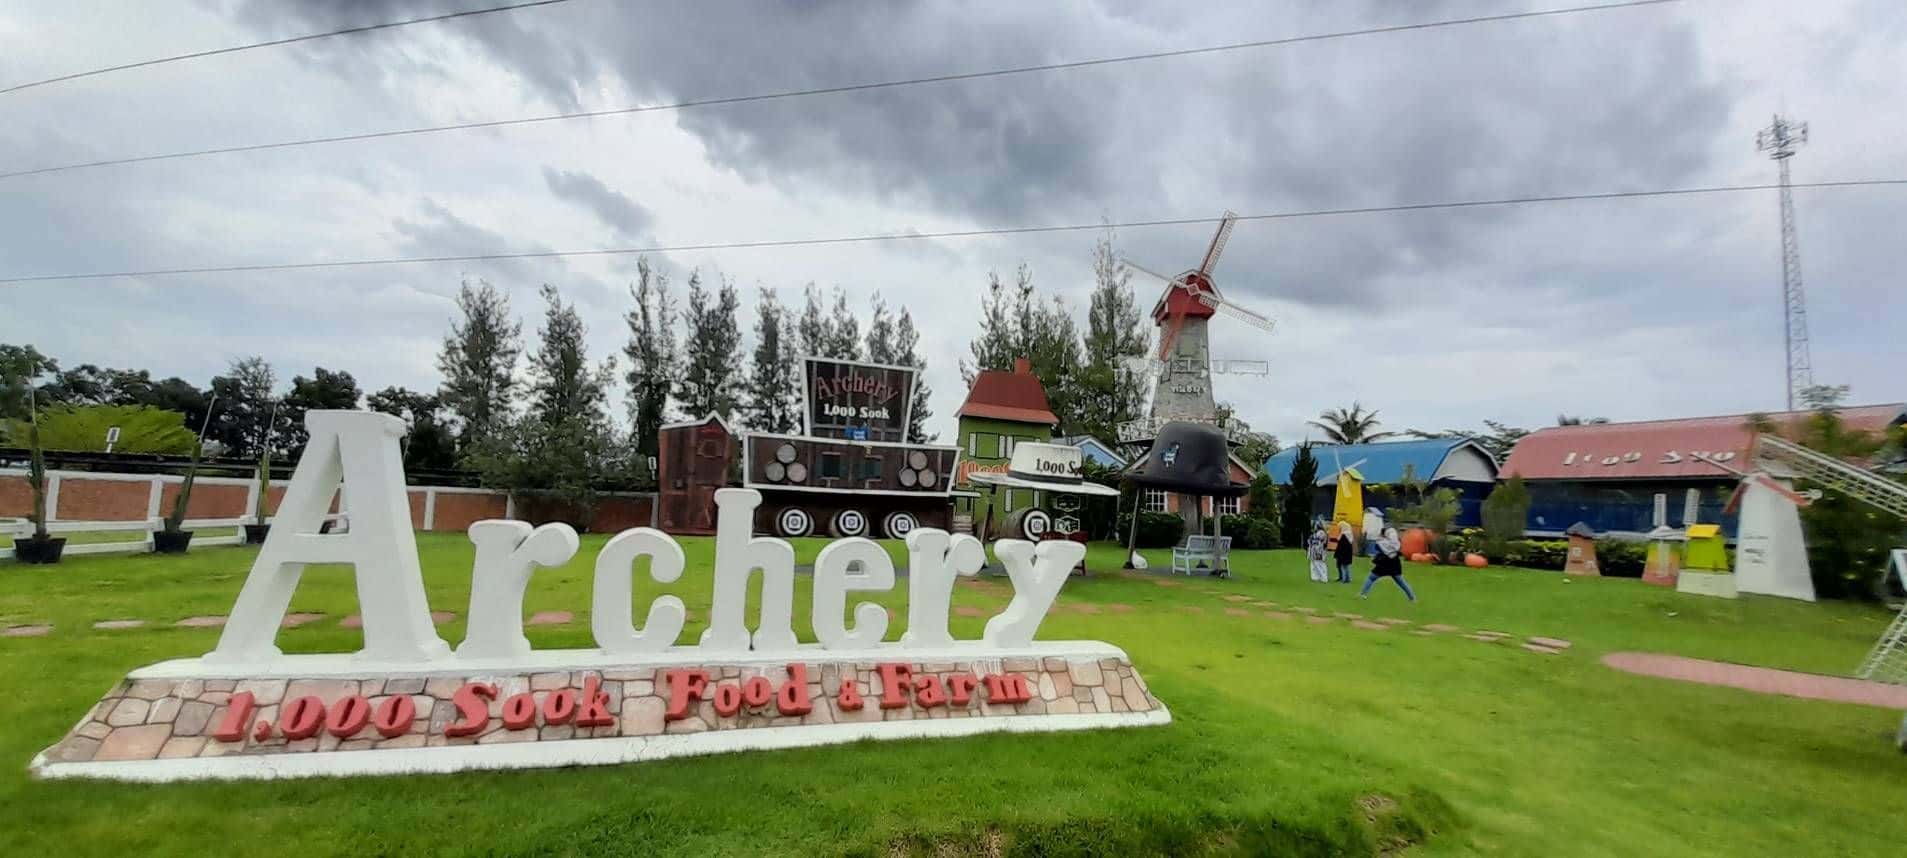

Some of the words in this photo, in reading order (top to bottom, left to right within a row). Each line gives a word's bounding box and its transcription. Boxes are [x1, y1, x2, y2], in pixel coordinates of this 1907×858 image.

[816, 370, 898, 404] Archery
[859, 407, 890, 420] Sook
[1036, 458, 1065, 474] 1,000
[200, 409, 1087, 663] Archery
[214, 690, 416, 742] 1,000
[444, 675, 614, 738] Sook
[664, 663, 813, 721] Food
[837, 678, 864, 711] &
[876, 662, 1032, 709] Farm
